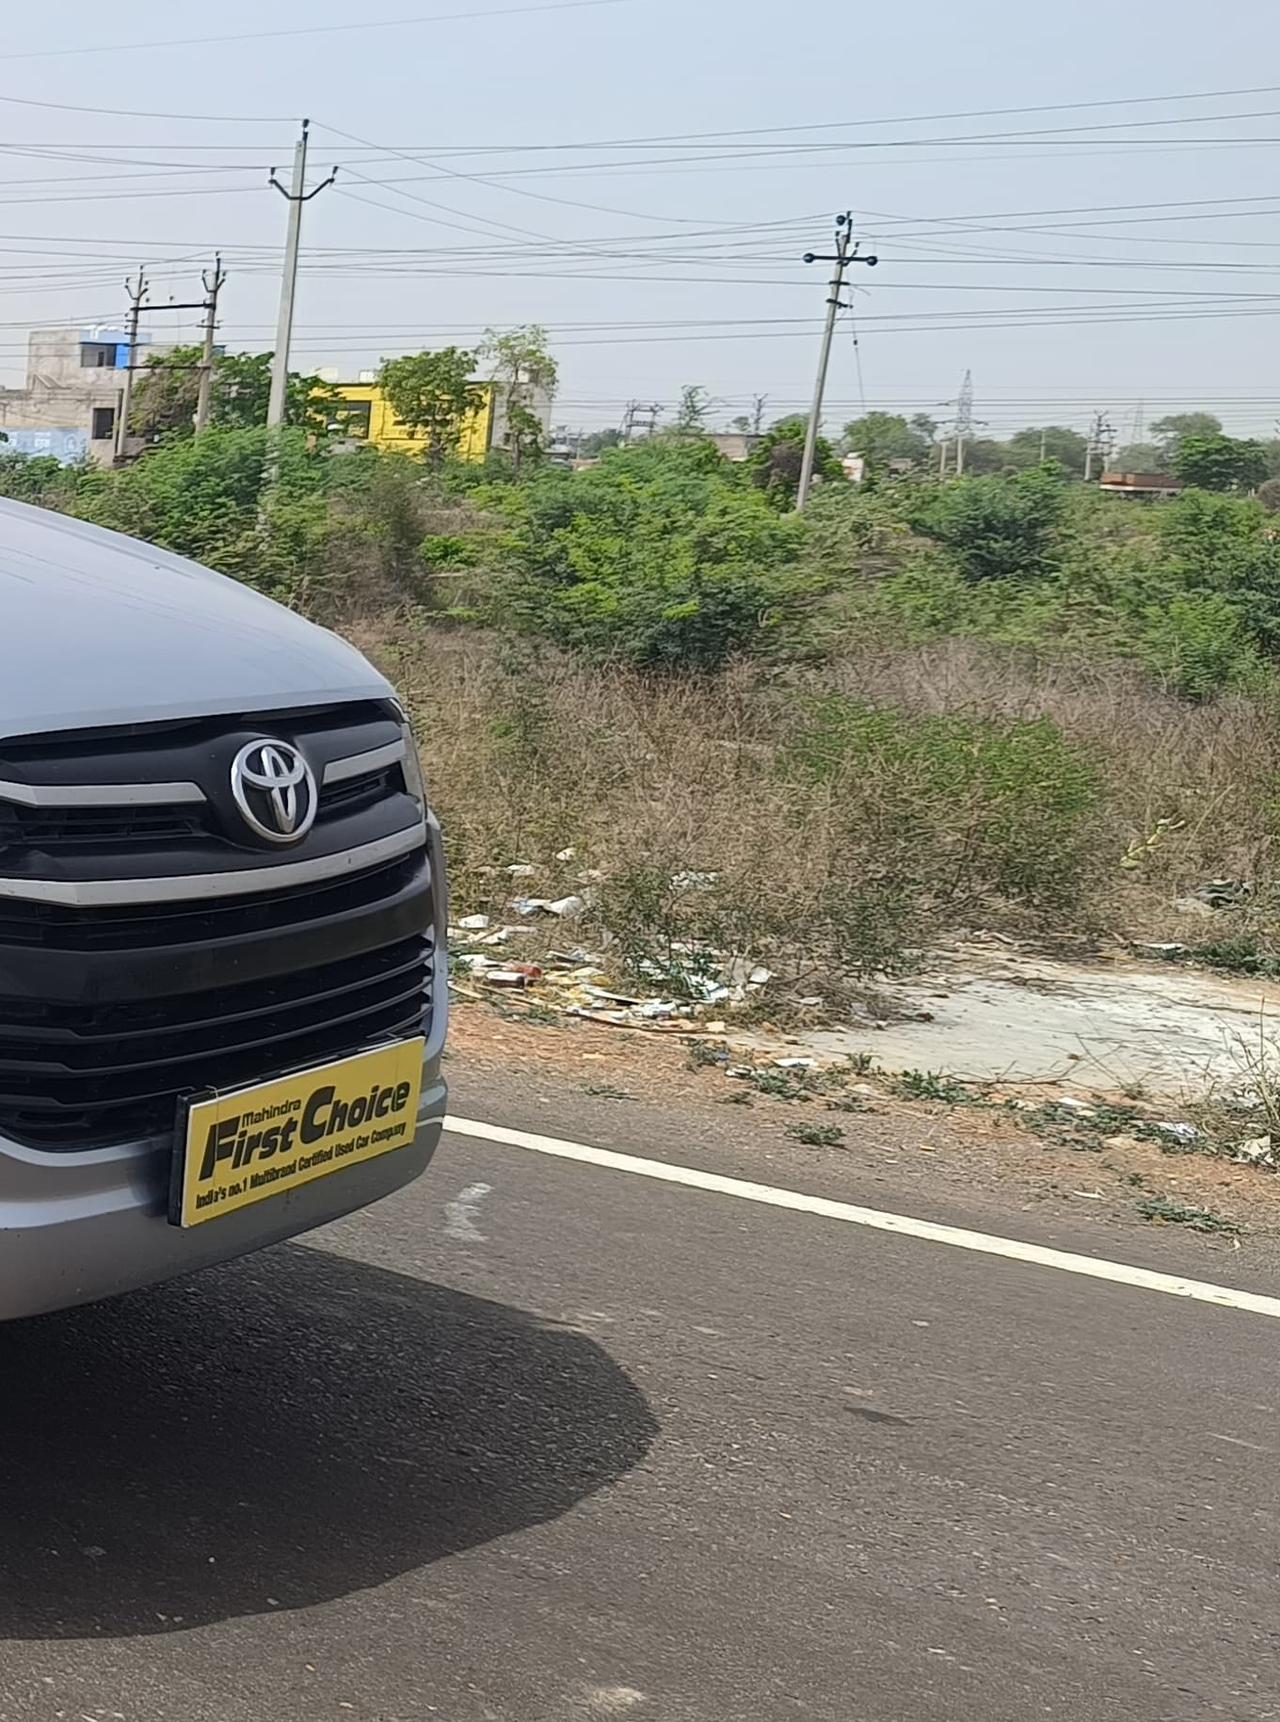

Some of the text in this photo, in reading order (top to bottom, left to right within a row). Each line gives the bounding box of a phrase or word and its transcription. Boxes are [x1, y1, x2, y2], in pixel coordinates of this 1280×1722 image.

[196, 1184, 227, 1209] India's
[250, 1159, 297, 1189] Multibrand
[298, 1146, 333, 1171] Certified
[334, 1138, 355, 1158] Used
[356, 1135, 370, 1149] Car
